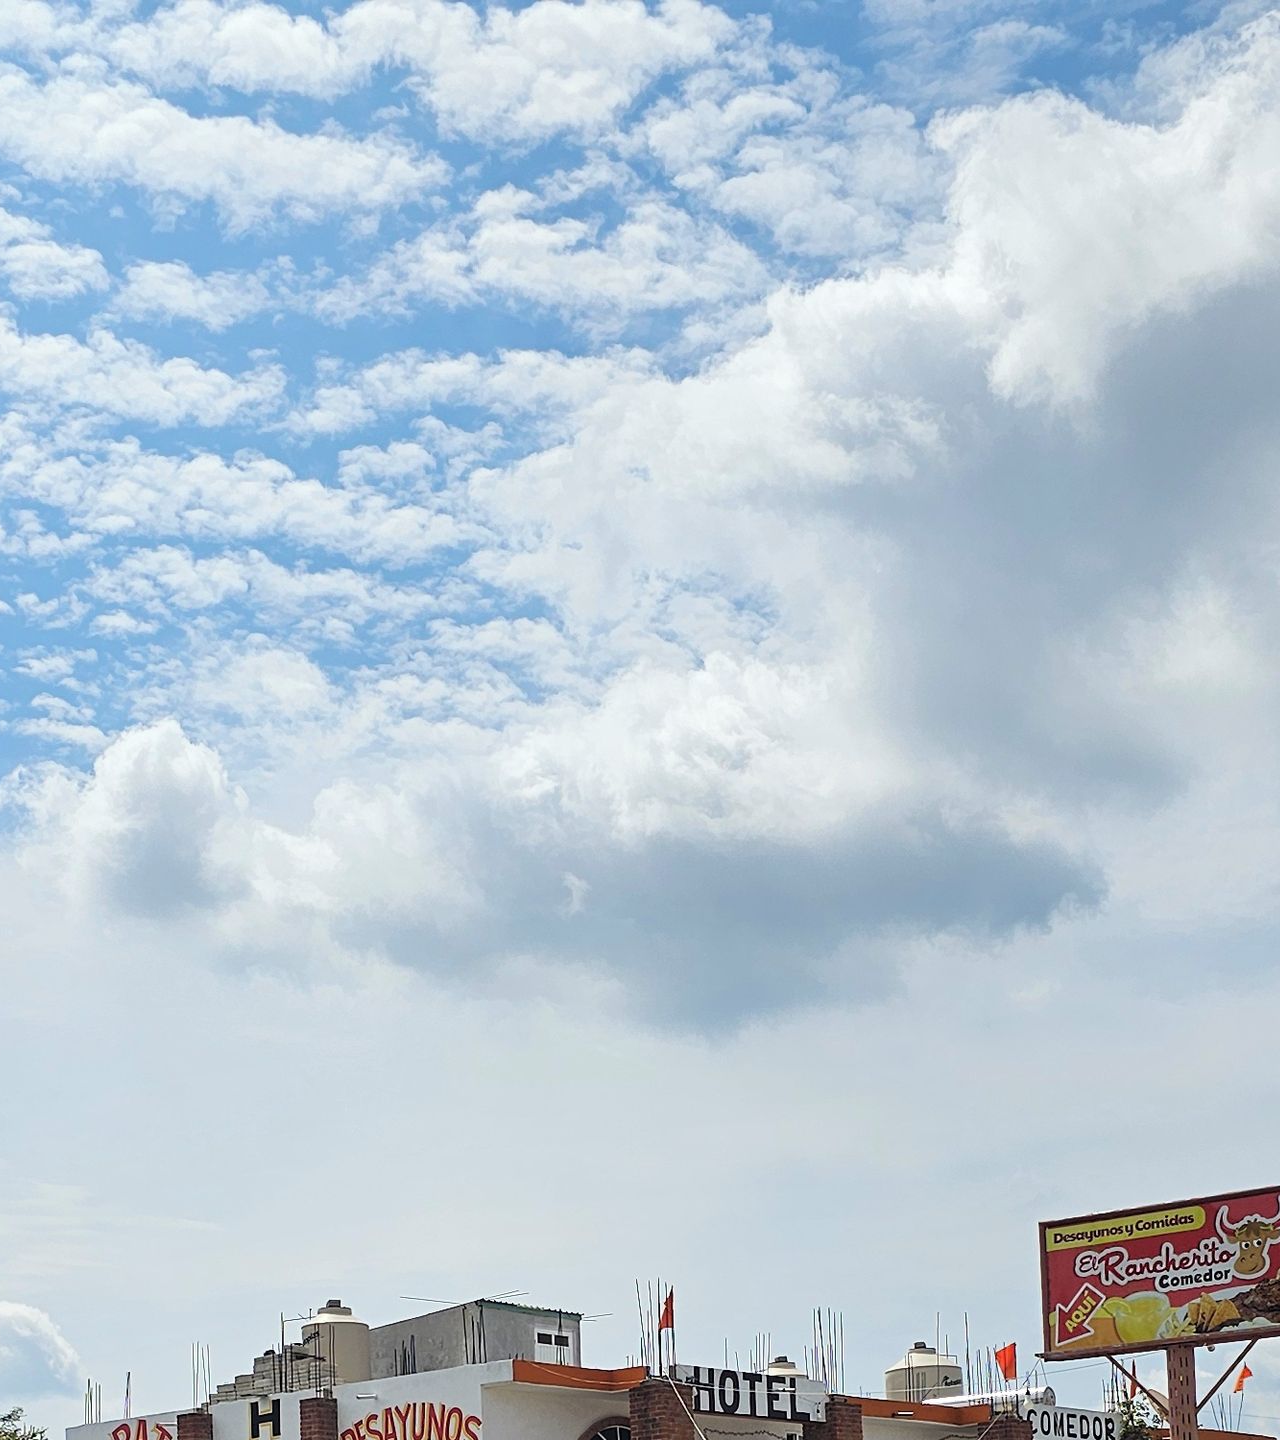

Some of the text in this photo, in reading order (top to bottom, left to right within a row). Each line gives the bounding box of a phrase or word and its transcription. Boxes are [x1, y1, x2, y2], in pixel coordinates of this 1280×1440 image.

[1053, 1214, 1195, 1244] Desayunos y Comidas
[1079, 1241, 1236, 1281] El Rancherito
[693, 1366, 811, 1422] HOTEL
